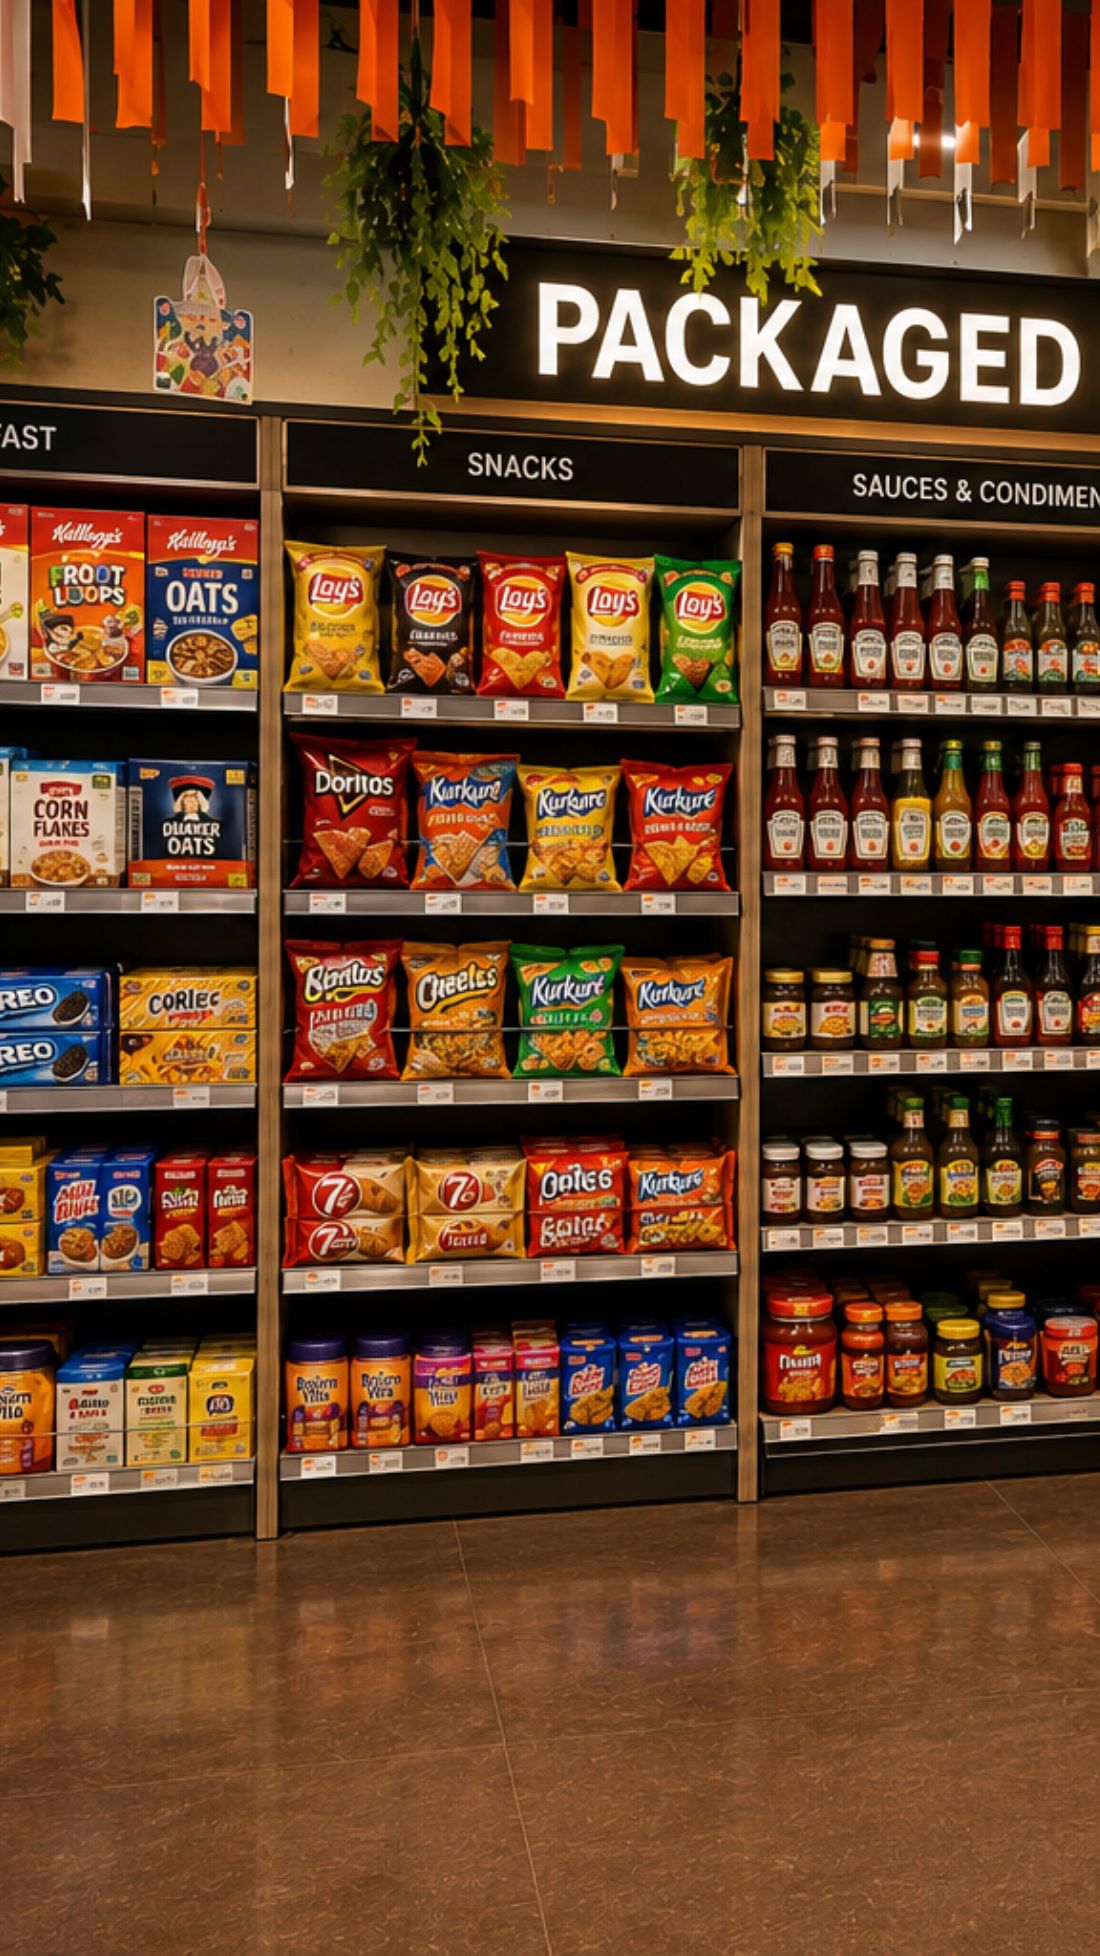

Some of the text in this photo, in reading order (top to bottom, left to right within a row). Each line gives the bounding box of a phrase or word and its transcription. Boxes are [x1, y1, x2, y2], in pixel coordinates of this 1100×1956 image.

[538, 282, 1081, 407] PACKAGED
[0, 423, 57, 451] AST
[468, 452, 574, 481] SNACKS
[853, 473, 948, 501] SAUCES
[955, 479, 972, 502] &
[50, 563, 125, 587] FROOT
[54, 586, 126, 606] LOOPS
[166, 580, 239, 614] OATS
[315, 770, 394, 796] Doritos
[34, 799, 89, 820] CORN
[645, 786, 717, 817] Kurkure
[33, 820, 90, 838] FLAKES
[167, 836, 216, 856] OATS
